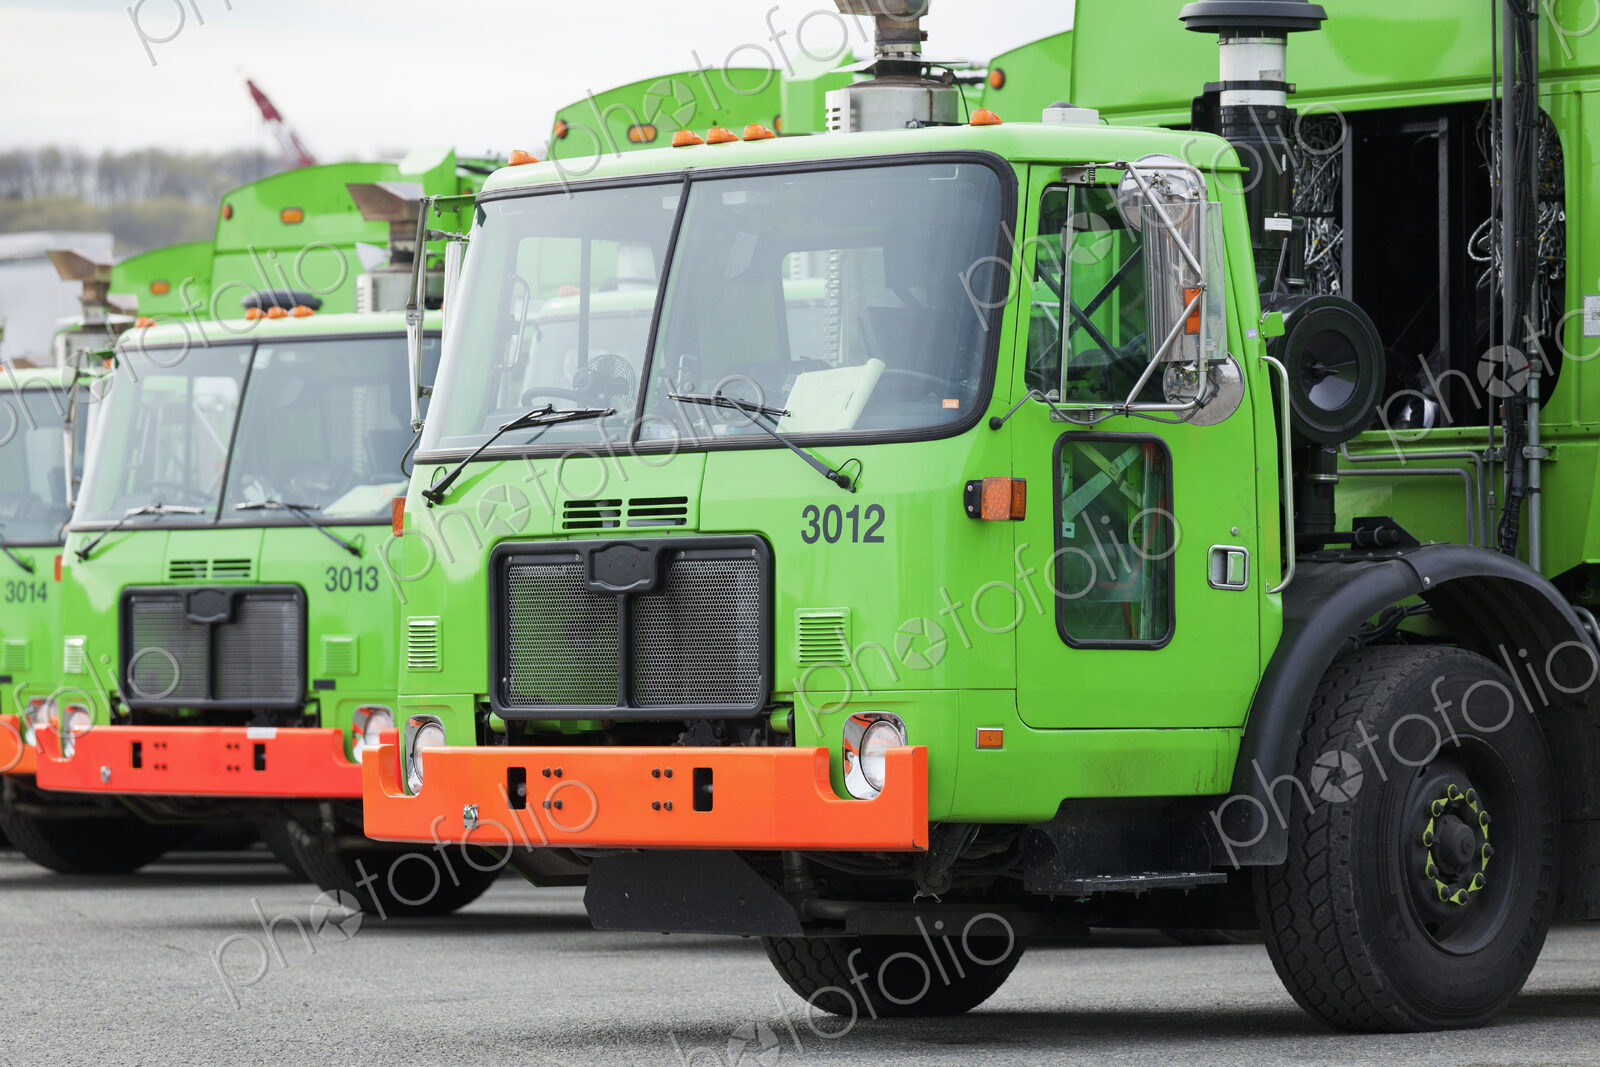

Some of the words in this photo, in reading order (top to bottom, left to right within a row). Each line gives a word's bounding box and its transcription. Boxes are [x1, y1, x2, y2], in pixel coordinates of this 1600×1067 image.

[801, 503, 885, 544] 3012
[5, 580, 47, 603] 3014
[325, 566, 379, 592] 3013
